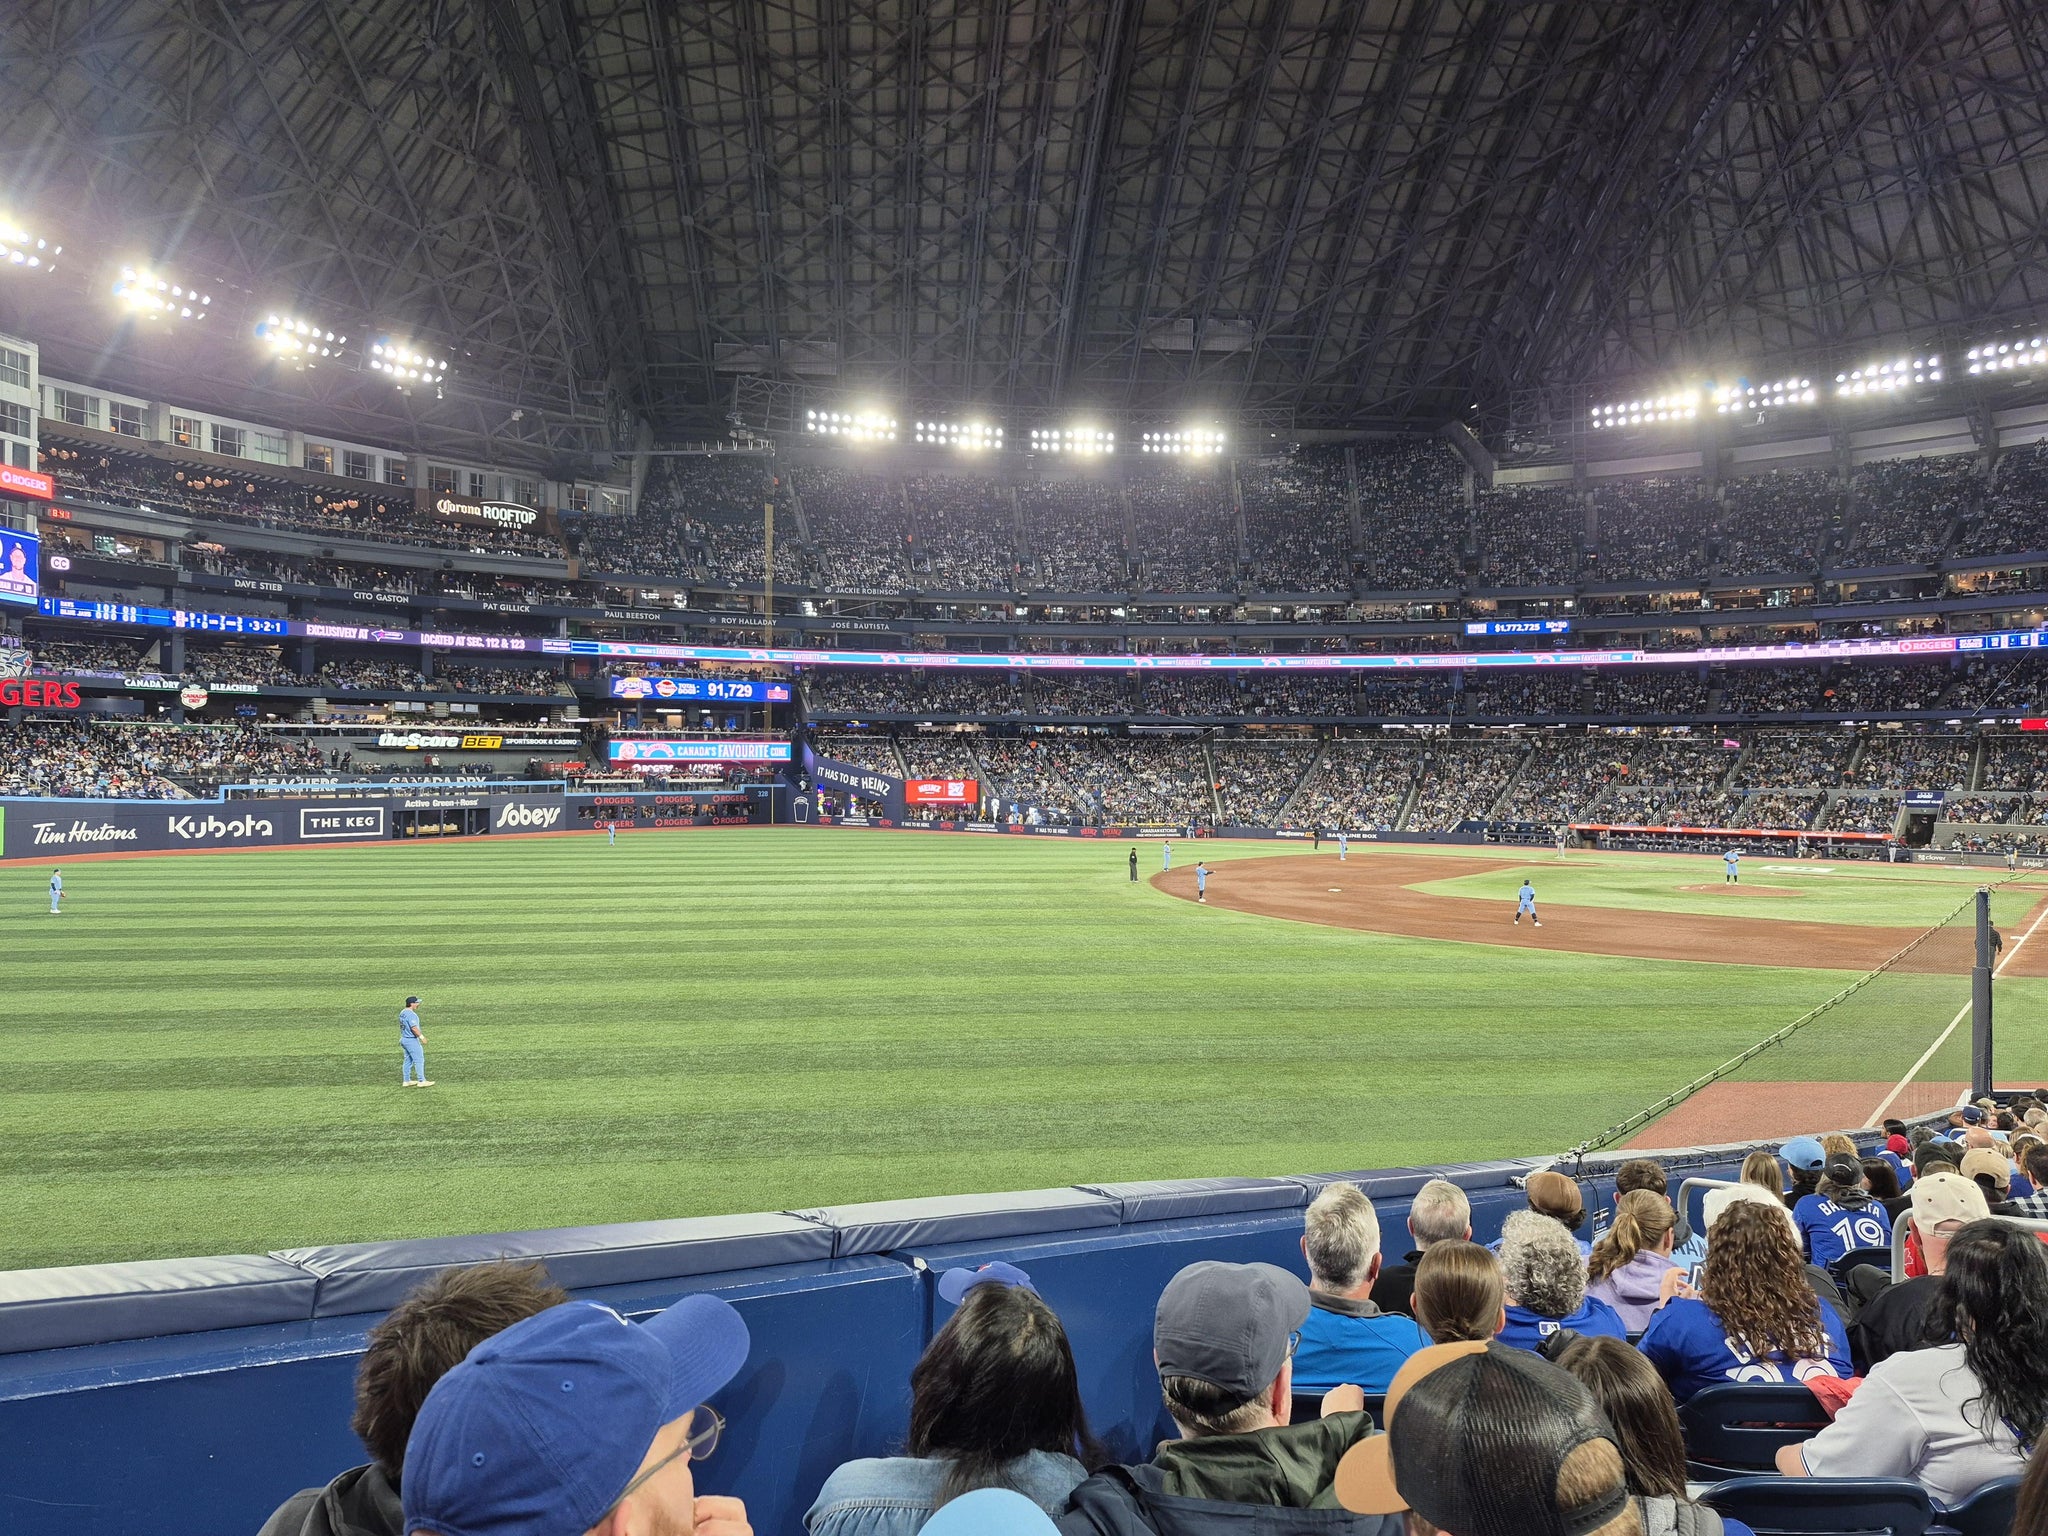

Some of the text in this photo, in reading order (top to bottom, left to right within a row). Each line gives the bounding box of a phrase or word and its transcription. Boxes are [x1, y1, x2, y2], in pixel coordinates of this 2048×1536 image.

[11, 473, 48, 491] ROGERS
[437, 499, 537, 525] Corona ROOFTOP
[498, 521, 522, 529] PATIO
[54, 559, 67, 568] CC
[235, 580, 283, 592] DAVE STIEB
[836, 587, 900, 596] JACKIE ROBINSON
[353, 591, 409, 604] CITO GASTON
[483, 603, 530, 613] PAT GILLICK
[604, 611, 661, 621] PAUL BEESTON
[721, 617, 777, 626] ROY HALLADAY
[307, 624, 369, 639] EXCLUSIVELY AT
[831, 620, 890, 631] JOSÉ BAUTISTA
[420, 633, 525, 649] LOCATED AT SEC. 112 & 123
[1913, 640, 1953, 650] ROGERS
[124, 679, 258, 692] CANADA DRY BLEACHERS
[707, 683, 753, 699] 91,729
[378, 732, 459, 748] theScore
[465, 737, 497, 747] BET
[505, 738, 548, 746] SPORTSBOOK
[677, 745, 717, 757] CANADA'S
[717, 744, 769, 758] FAVOURITE
[817, 766, 824, 776] IT
[824, 769, 838, 781] HAS
[839, 772, 849, 784] TO
[850, 776, 859, 787] BE
[861, 776, 891, 796] HEINZ
[405, 799, 430, 808] Active
[603, 797, 635, 805] ROGERS
[663, 795, 693, 803] ROGERS
[496, 802, 561, 828] Sobeys
[720, 816, 749, 824] ROGERS
[168, 814, 273, 839] Kubota
[310, 816, 375, 828] THE KEG
[663, 818, 693, 826] ROGERS
[32, 822, 66, 845] Tim
[1831, 1217, 1884, 1252] 19
